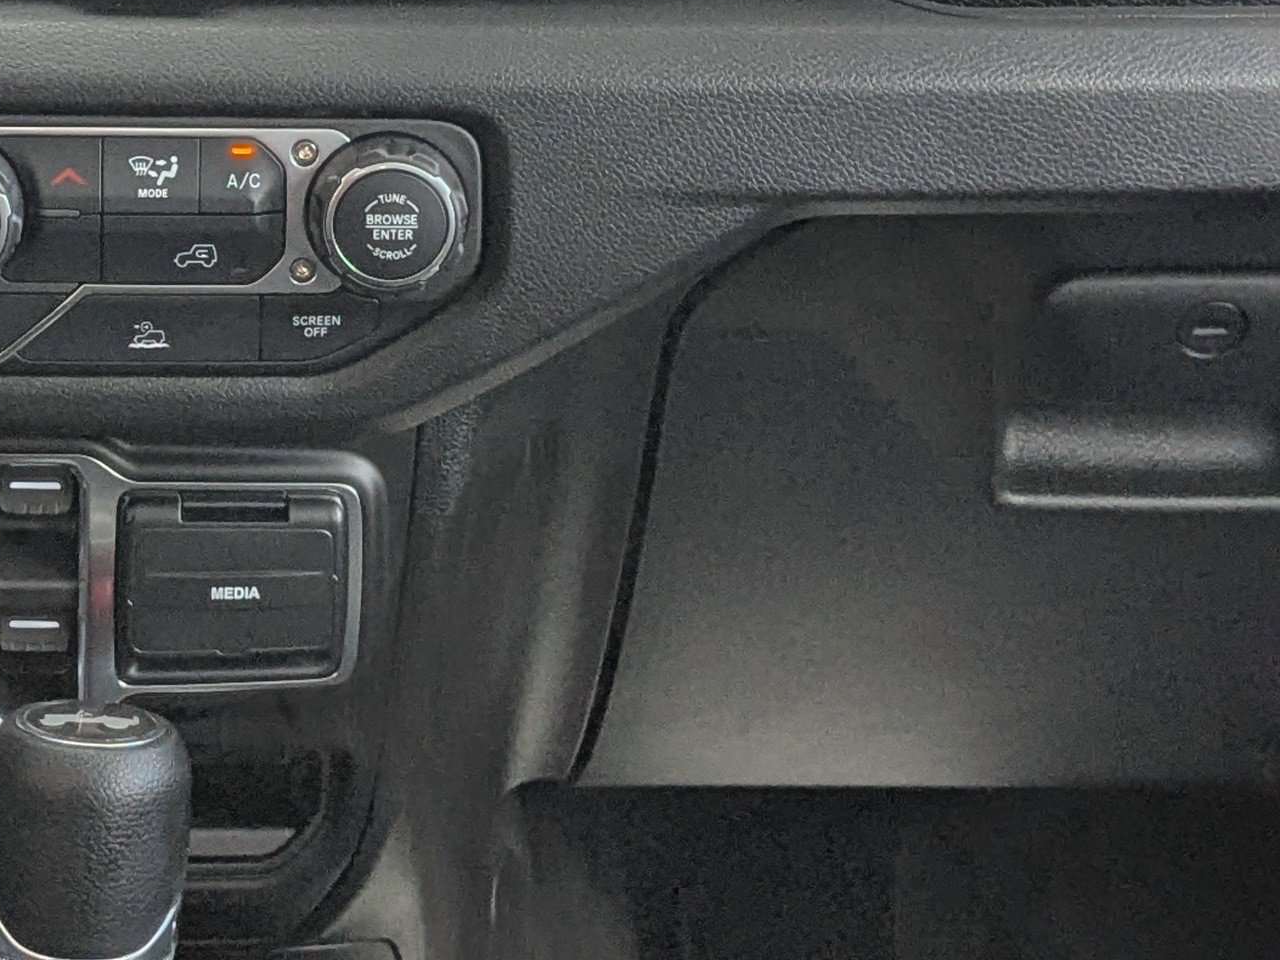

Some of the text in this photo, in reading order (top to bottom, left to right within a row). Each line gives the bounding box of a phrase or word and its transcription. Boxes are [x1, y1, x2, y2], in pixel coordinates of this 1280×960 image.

[225, 172, 262, 190] A/C
[137, 188, 169, 199] MODE
[376, 193, 409, 206] TUNE
[365, 213, 419, 226] BROWSE
[372, 229, 414, 241] ENTER
[370, 246, 413, 261] SCROLL
[291, 315, 342, 327] SCREEN
[303, 326, 329, 338] OFF
[210, 586, 261, 601] MEDIA
